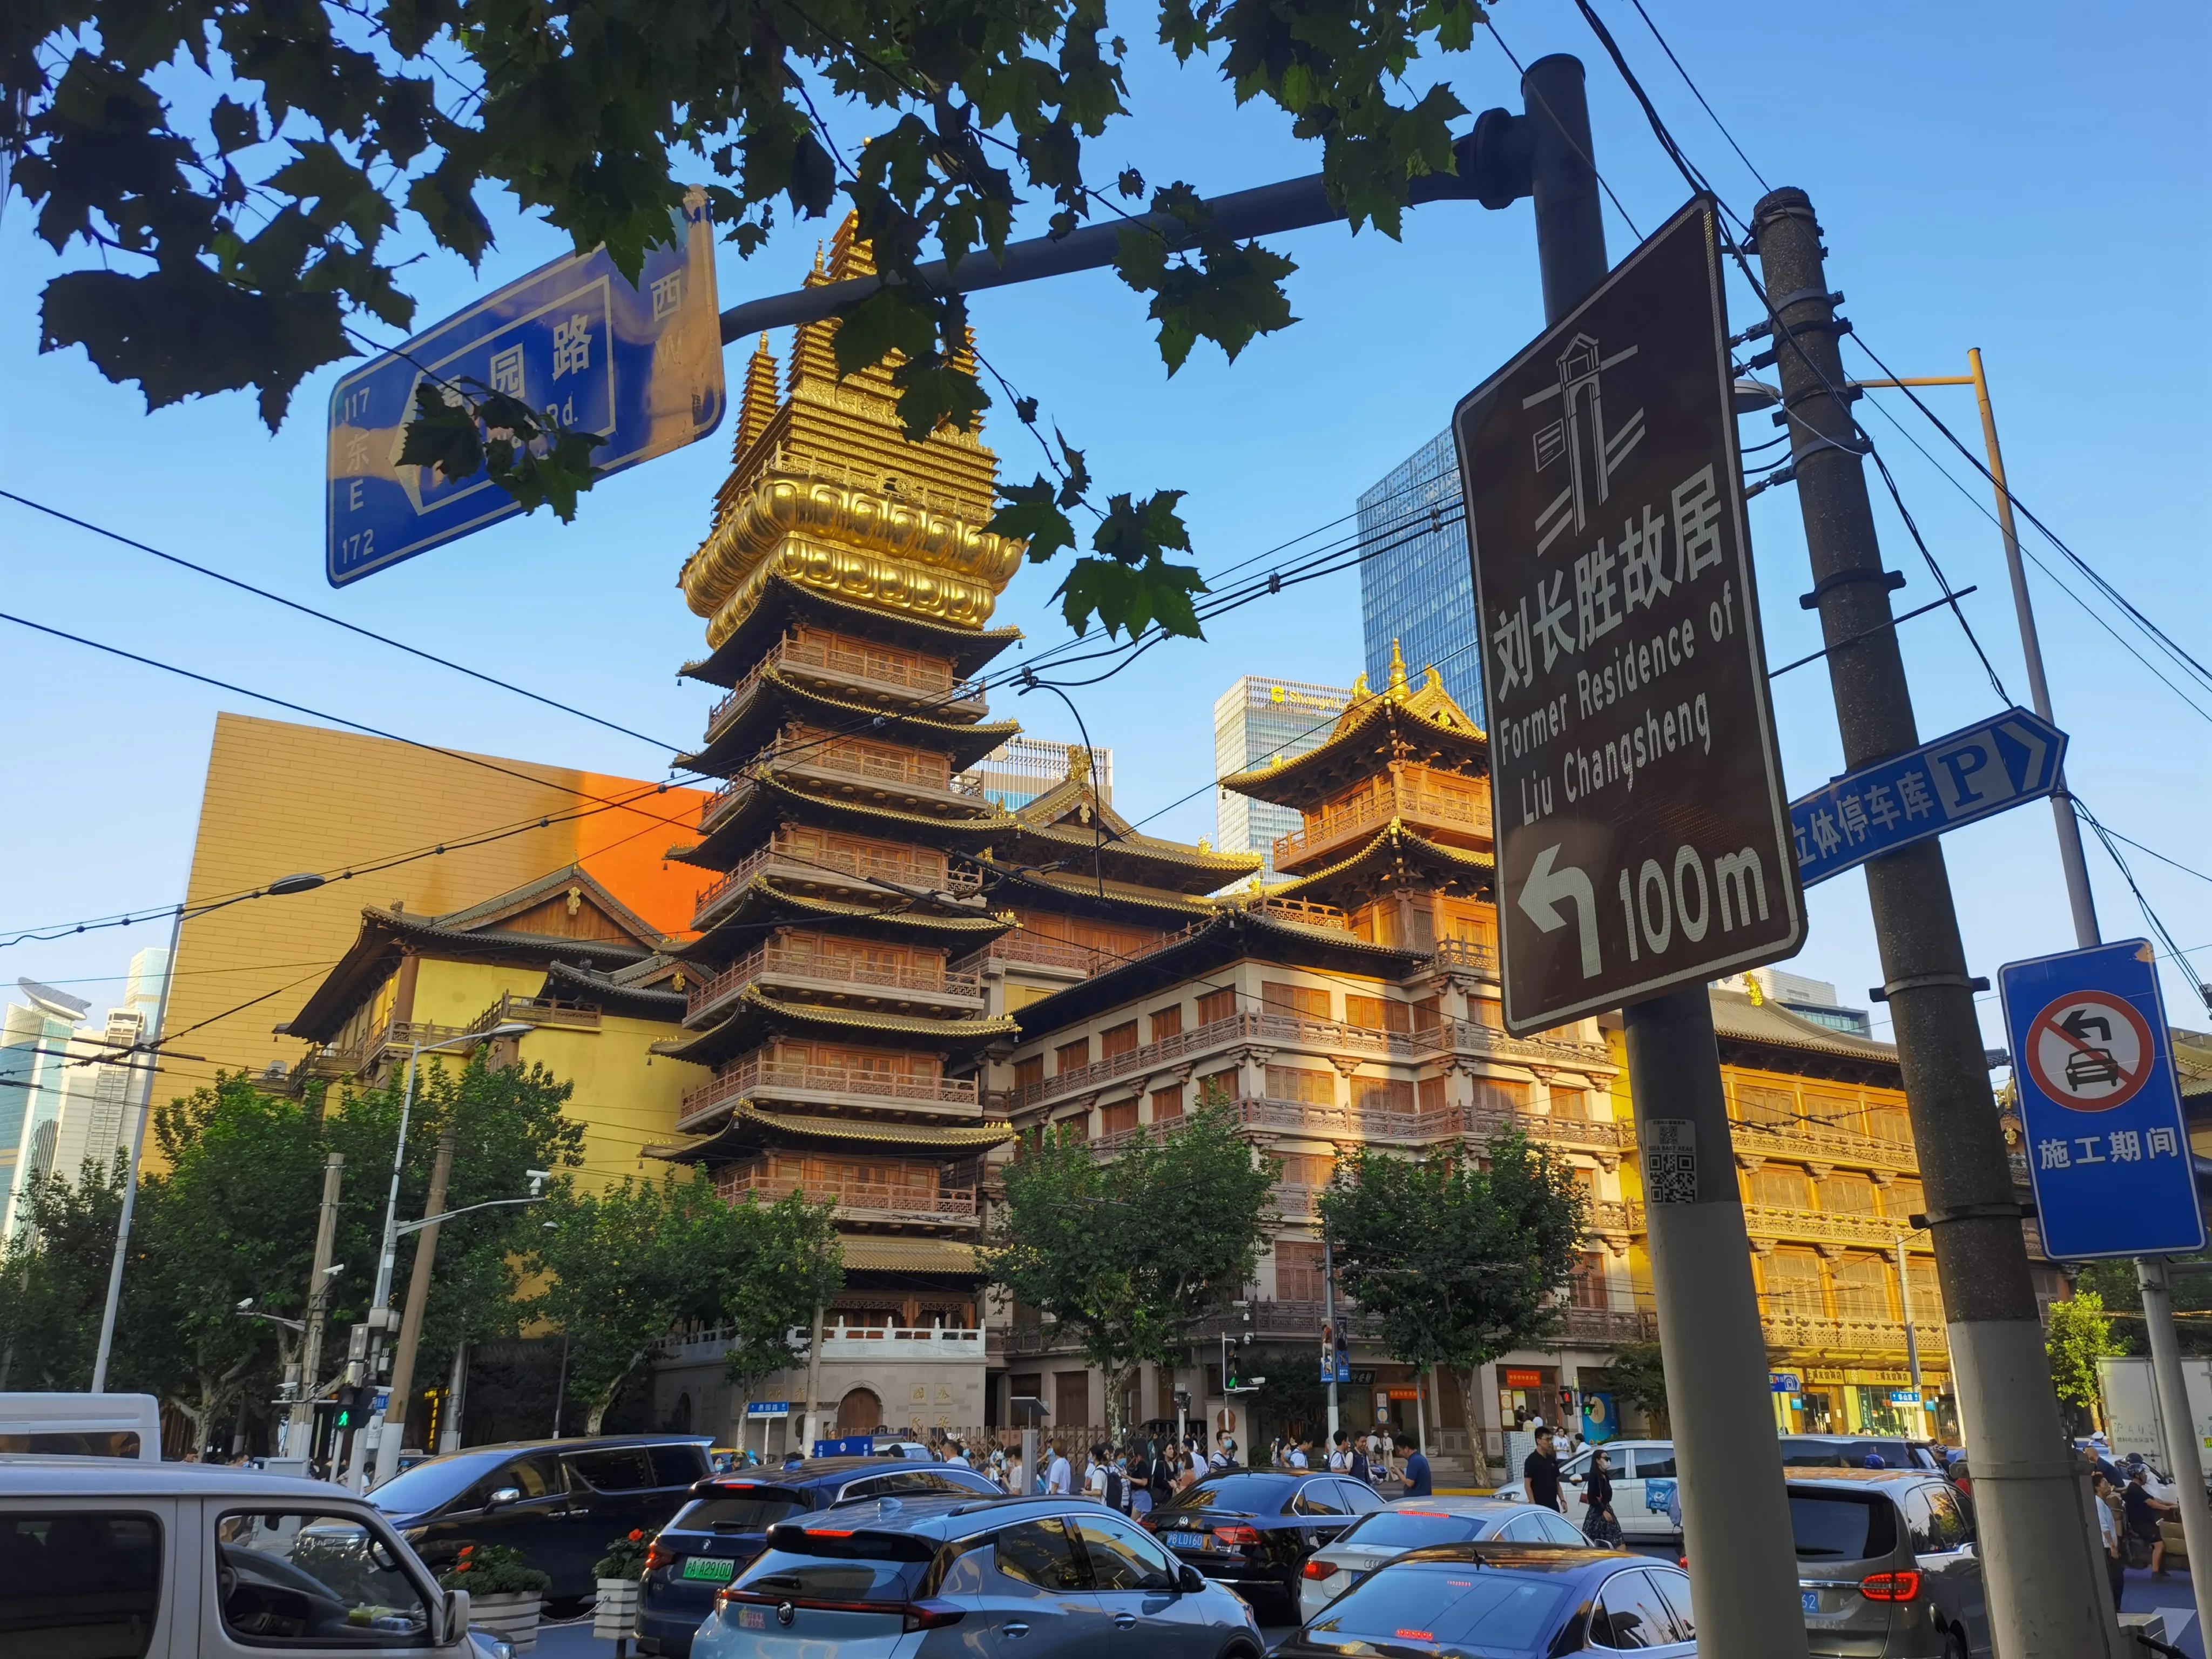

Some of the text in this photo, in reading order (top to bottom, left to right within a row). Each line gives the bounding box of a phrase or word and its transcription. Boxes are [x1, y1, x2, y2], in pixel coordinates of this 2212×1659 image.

[651, 269, 682, 322] 西
[655, 327, 685, 371] W
[345, 386, 370, 422] 117
[346, 430, 370, 474] 东
[350, 478, 364, 512] E
[342, 529, 374, 564] 172
[1493, 462, 1723, 703] 刘长胜故居
[1500, 579, 1733, 765] Former Residence of
[1521, 692, 1711, 826] Liu Changsheng
[1937, 745, 1988, 808] P
[1792, 771, 1934, 867] 立体停车库
[1619, 844, 1769, 961] 100m
[2038, 1127, 2178, 1170] 施工期间
